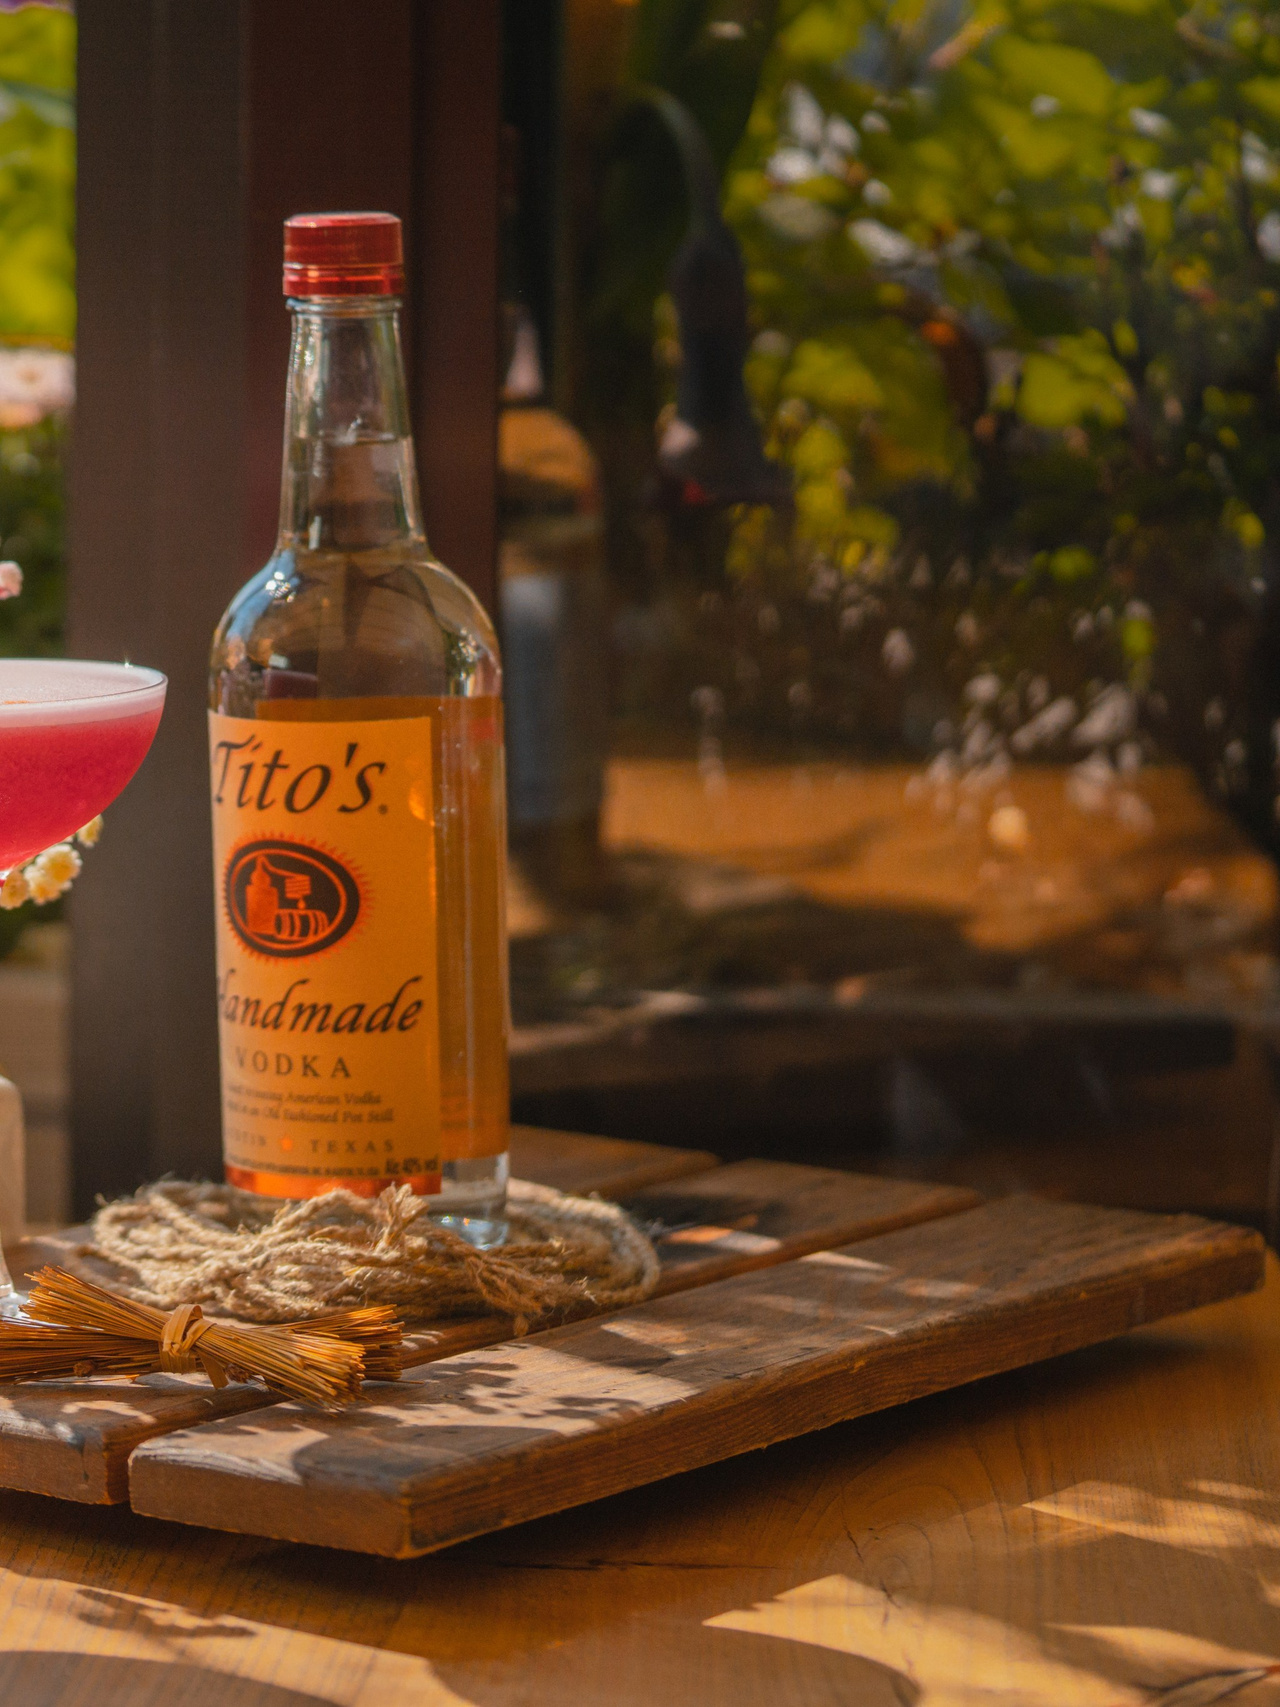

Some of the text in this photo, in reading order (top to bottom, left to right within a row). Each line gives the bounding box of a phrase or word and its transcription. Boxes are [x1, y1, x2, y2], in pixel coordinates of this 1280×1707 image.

[213, 733, 386, 814] Tito's
[235, 1045, 351, 1078] VODKA
[343, 1089, 382, 1105] Vodka
[310, 1138, 395, 1154] TEXAS
